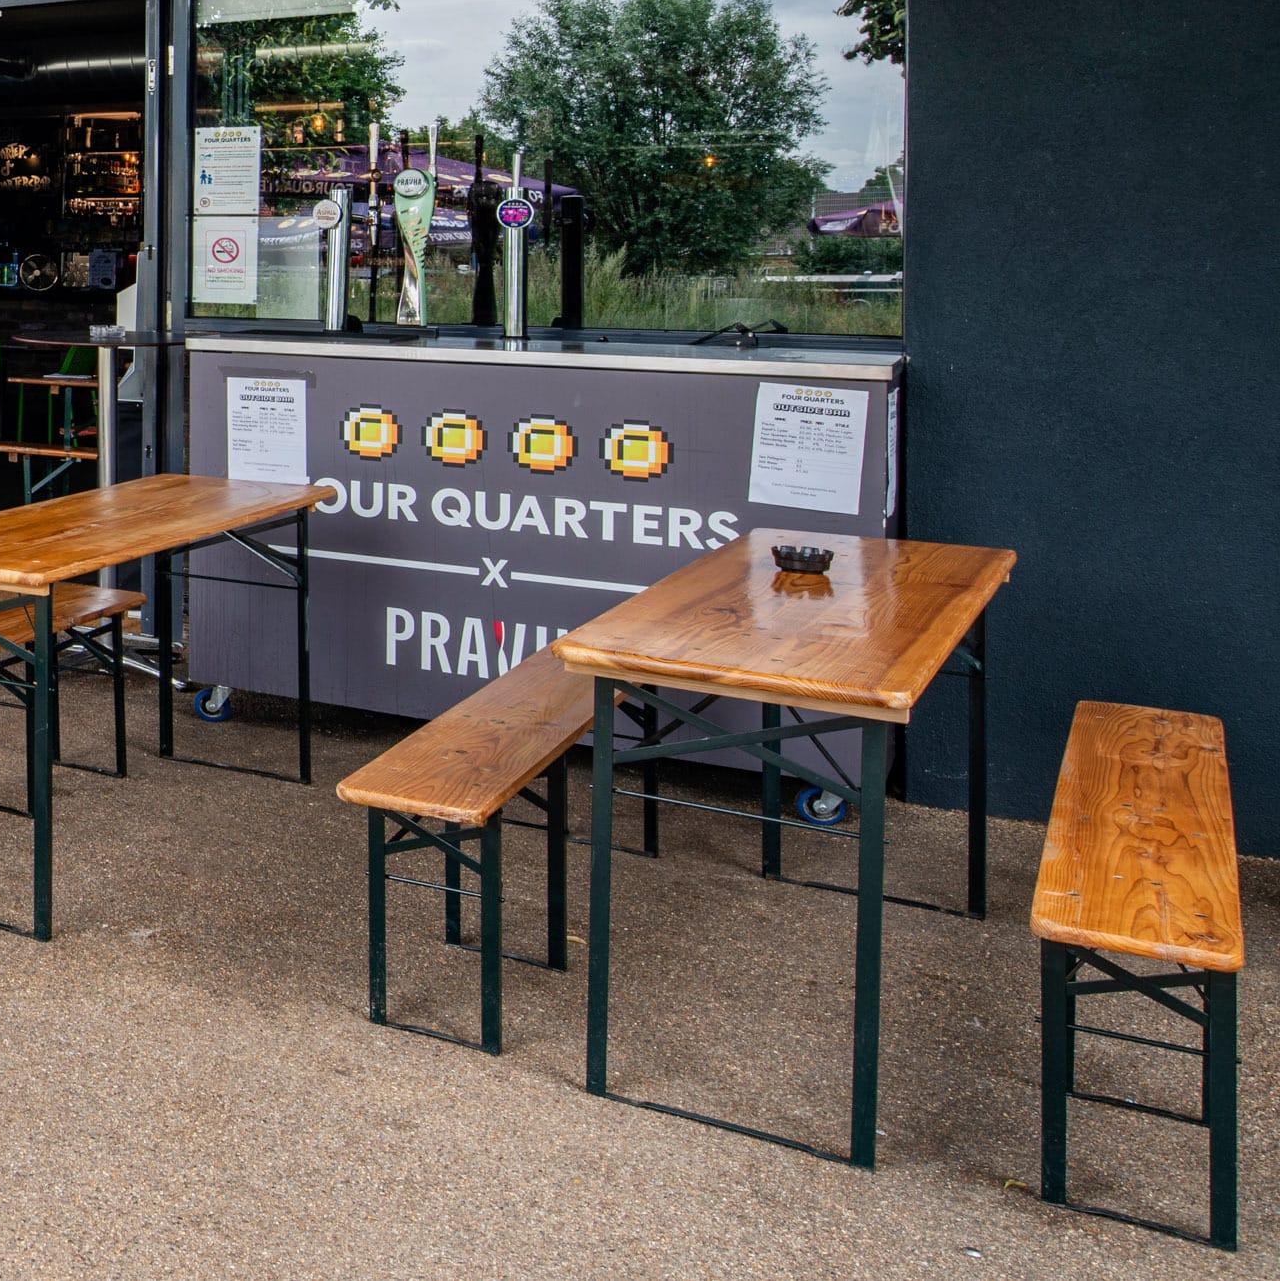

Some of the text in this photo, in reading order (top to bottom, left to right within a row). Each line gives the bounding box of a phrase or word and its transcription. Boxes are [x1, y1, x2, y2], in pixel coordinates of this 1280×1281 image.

[397, 178, 422, 186] PRAVHA
[781, 393, 845, 405] FOUR QUARTERS
[773, 403, 851, 417] OUTSIDE BAR
[312, 477, 740, 550] OUR QUARTERS
